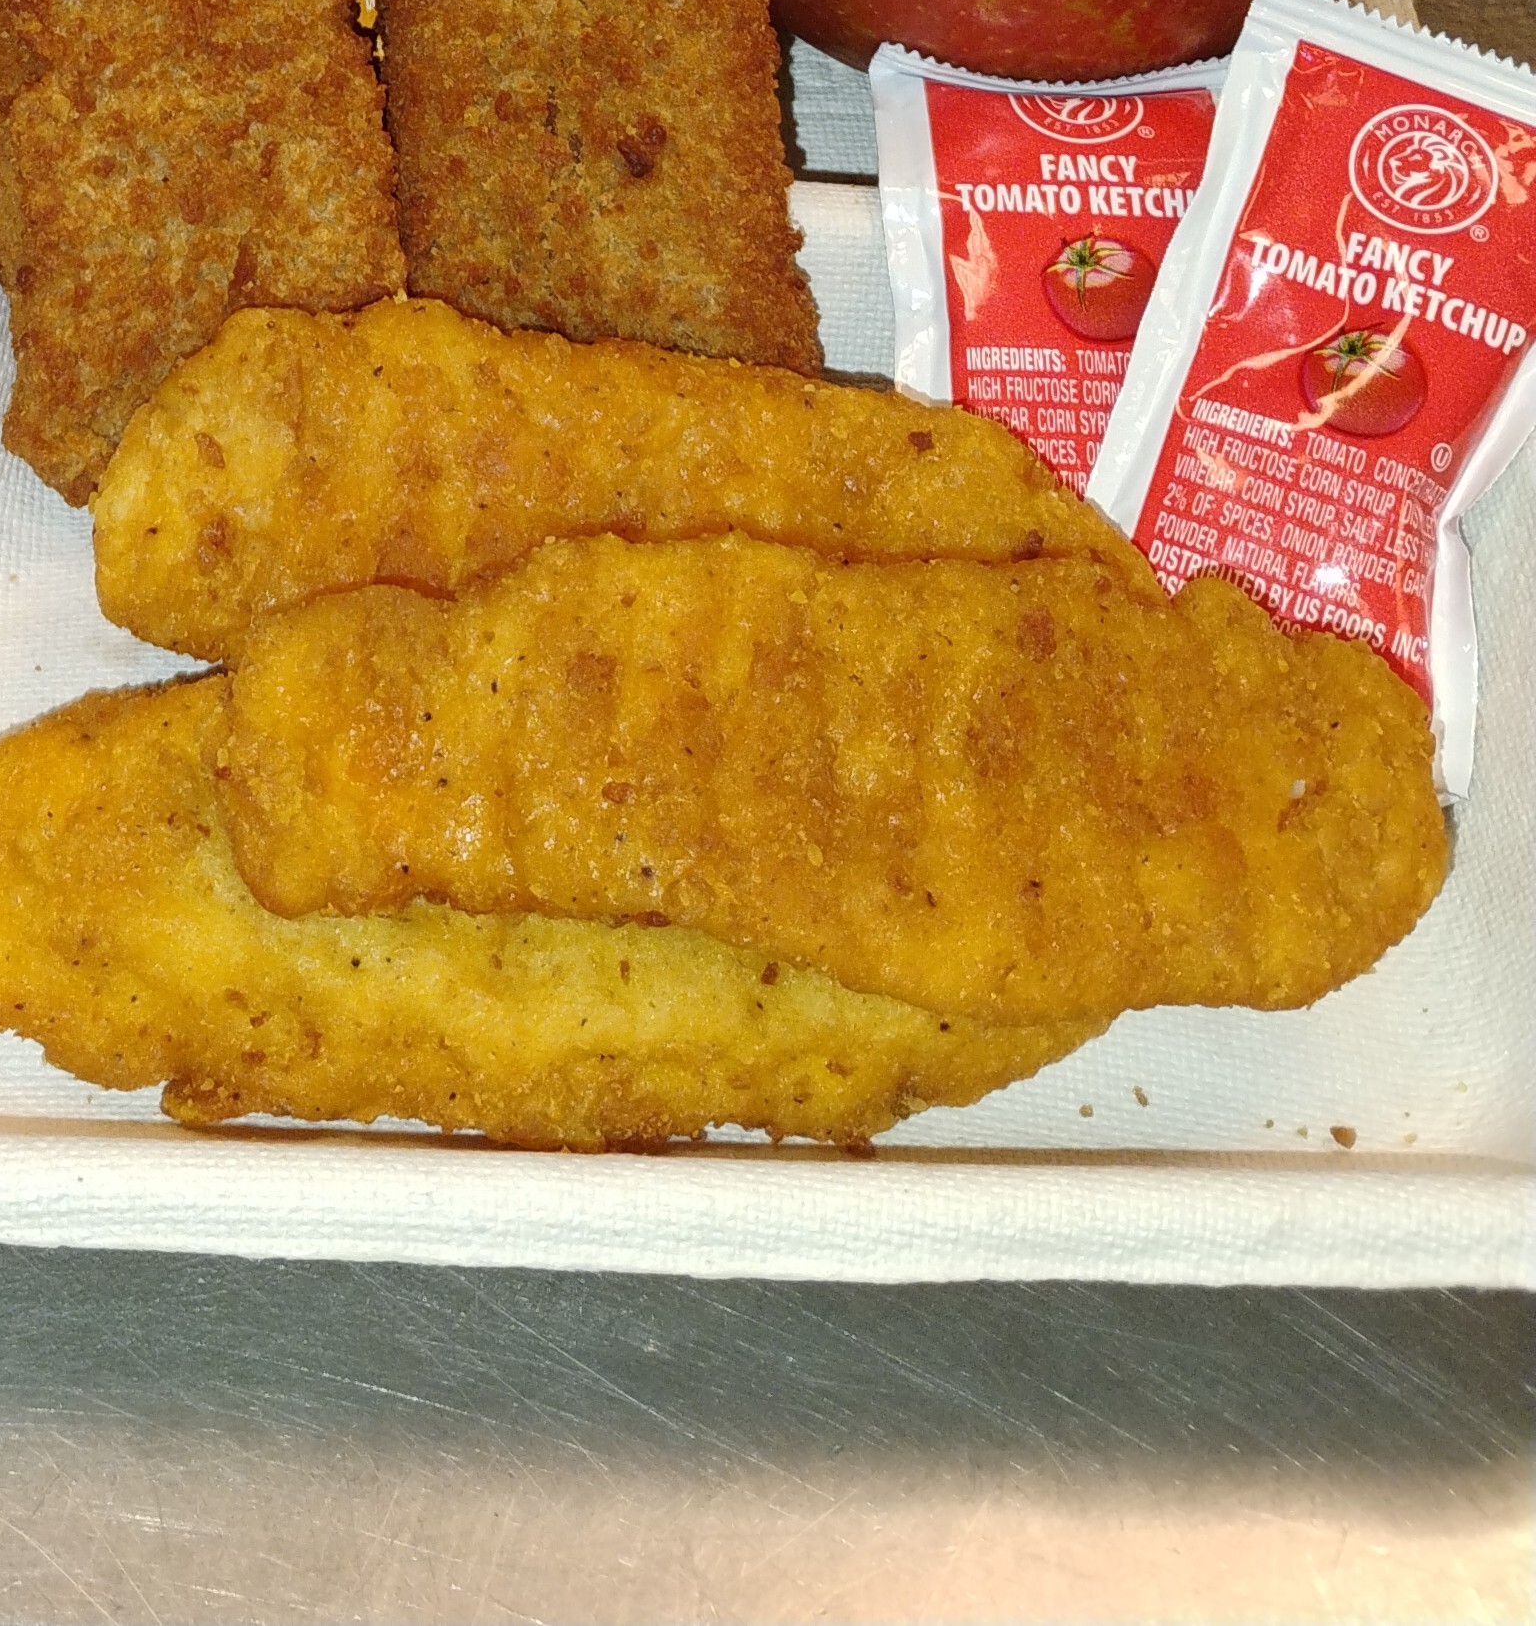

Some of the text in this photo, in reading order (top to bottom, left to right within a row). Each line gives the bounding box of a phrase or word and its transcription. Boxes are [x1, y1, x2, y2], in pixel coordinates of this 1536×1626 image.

[1373, 113, 1488, 170] MONARCH
[1040, 153, 1137, 184] FANCY
[955, 182, 1083, 215] TOMATO
[1345, 230, 1455, 287] FANCY
[1250, 237, 1528, 356] TOMATO KETCHUP
[966, 346, 1066, 374] INGREDIENTS:
[967, 375, 1123, 406] HIGH FRUCTOSE CORN
[1036, 408, 1077, 434] CORN
[1191, 397, 1368, 475] INGREDIENTS: TOMATO
[1182, 425, 1220, 454] HIGH
[1221, 436, 1298, 484] FRUCTOSE
[1298, 462, 1348, 499] CORN
[1344, 479, 1397, 521] SYRUP,
[1241, 476, 1286, 512] CORN
[1163, 482, 1328, 561] 2% SPICES, ONION
[1224, 534, 1289, 582] NATURAL
[1267, 586, 1292, 618] BY
[1293, 596, 1321, 624] US
[1320, 604, 1389, 654] FOODS,
